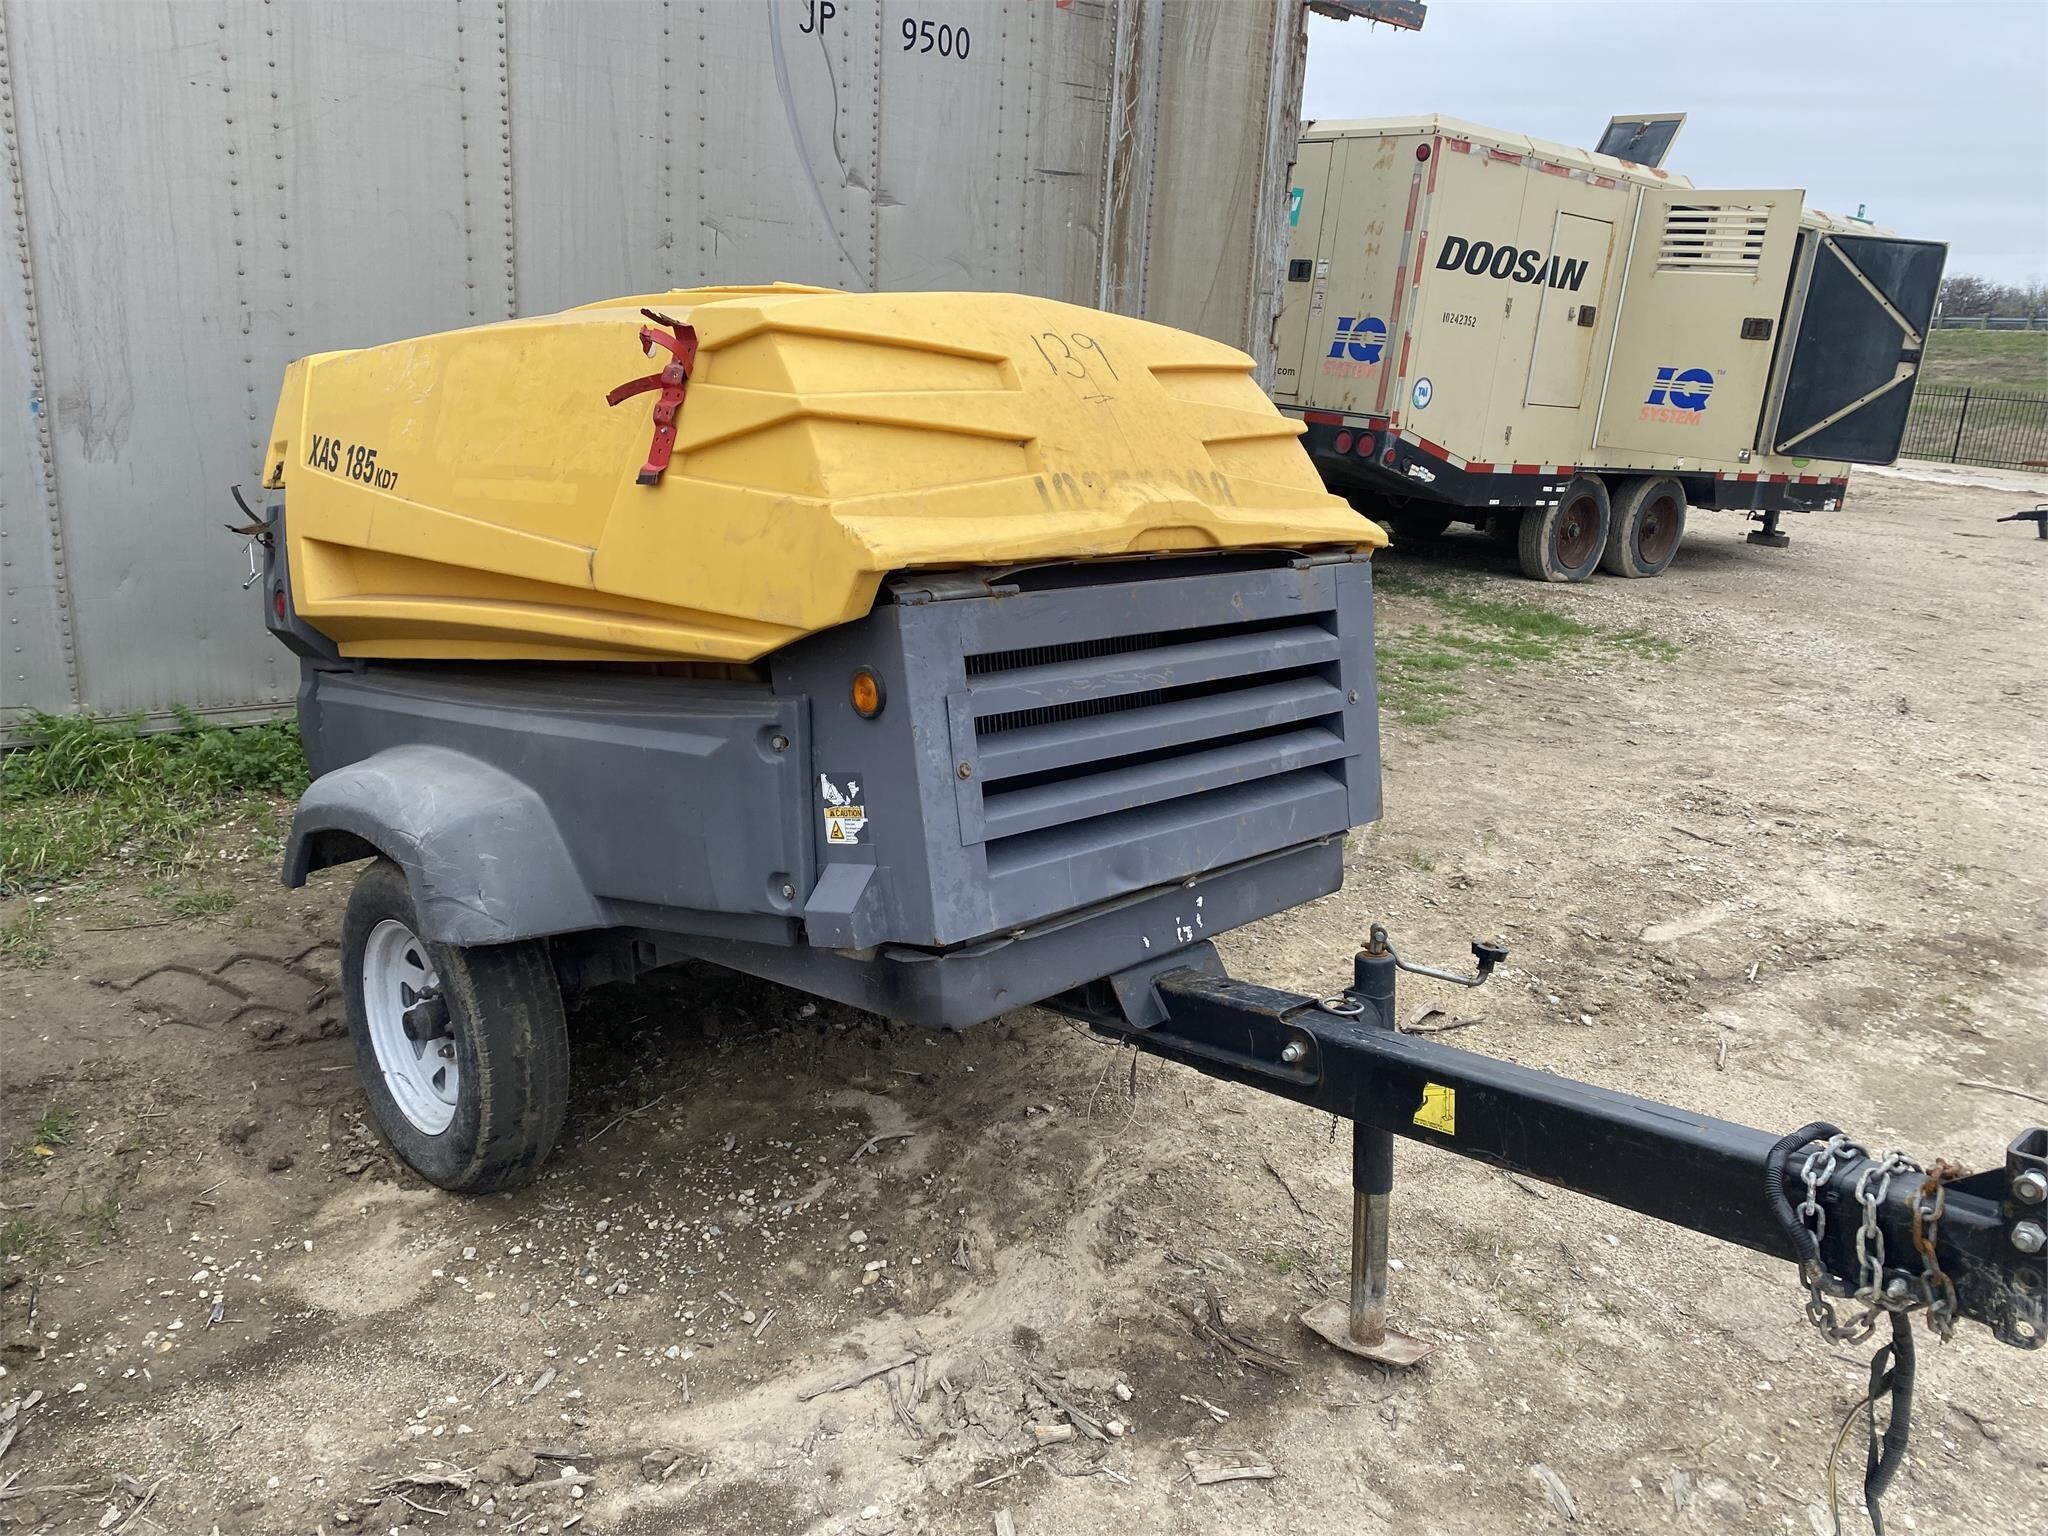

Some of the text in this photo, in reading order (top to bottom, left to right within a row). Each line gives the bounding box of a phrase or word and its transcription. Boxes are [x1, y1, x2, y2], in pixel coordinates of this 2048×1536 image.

[799, 0, 970, 60] JP 9500
[1436, 236, 1589, 291] DOOSAN
[1327, 317, 1387, 365] IQ
[1442, 312, 1477, 328] 10242352
[1029, 333, 1119, 381] 139
[1644, 367, 1714, 412] IQ
[1639, 406, 1703, 426] SYSTEM
[308, 434, 398, 491] XAS 185 KD7
[835, 809, 862, 817] CAUTION
